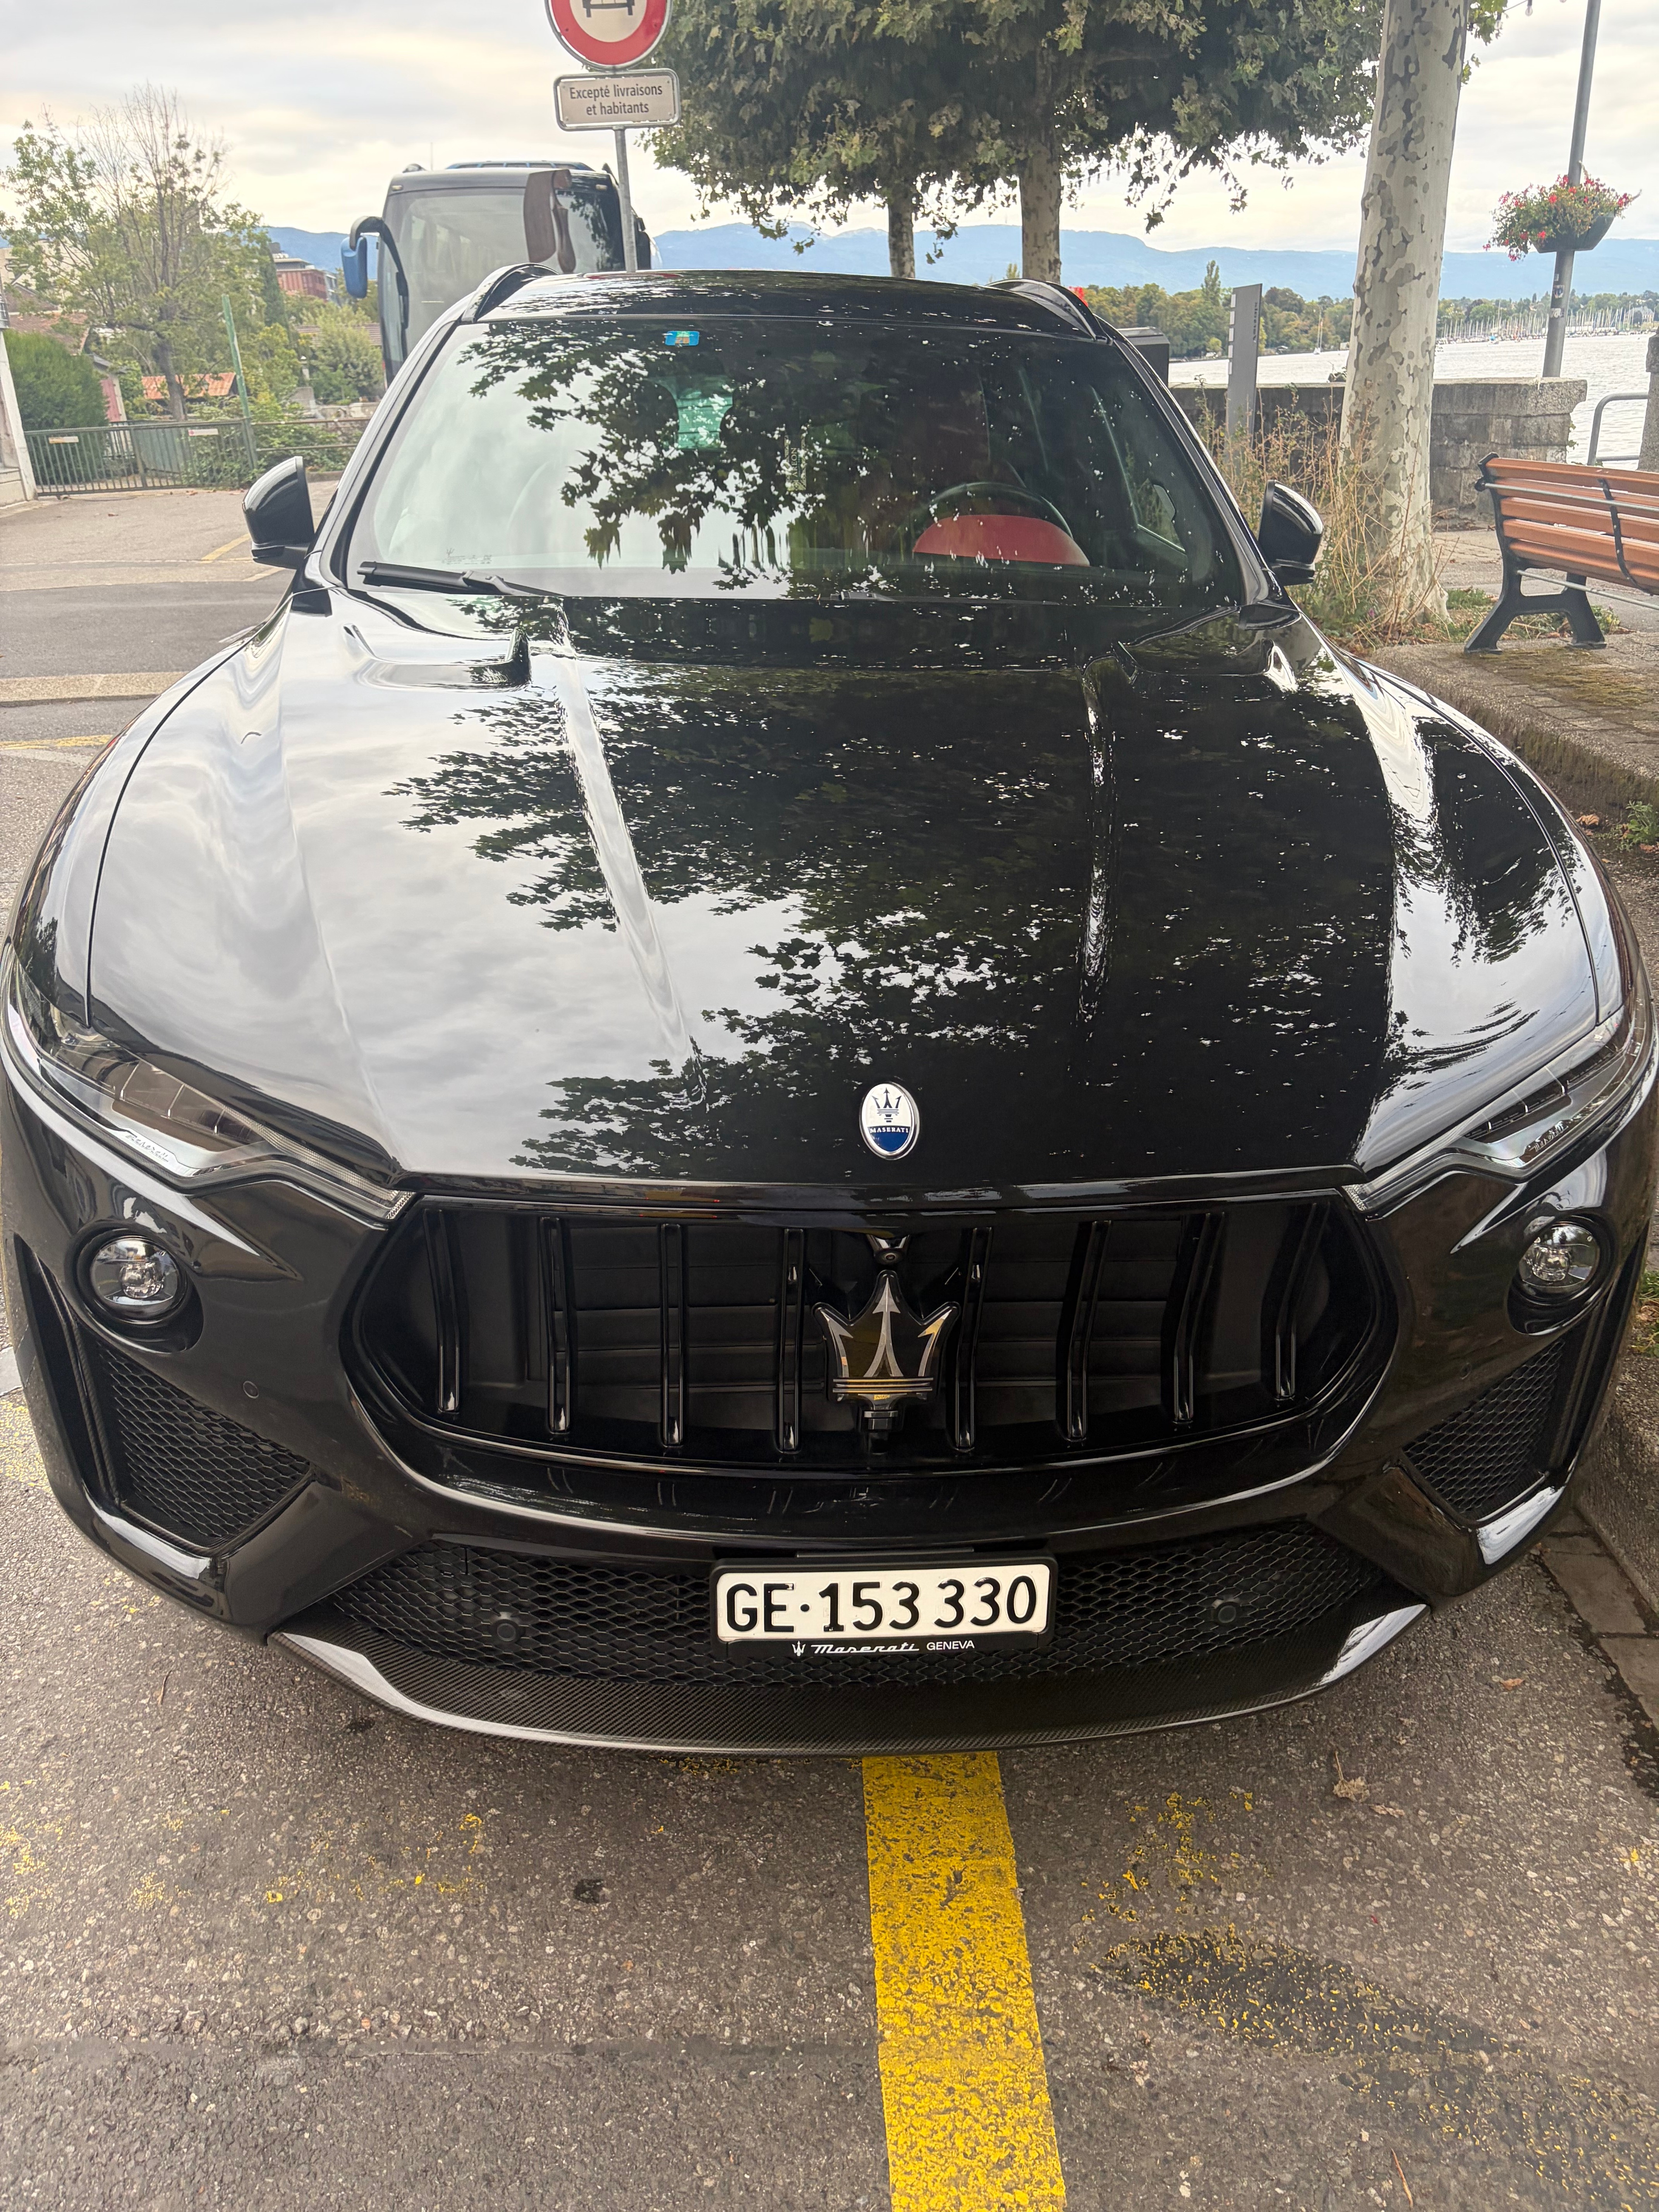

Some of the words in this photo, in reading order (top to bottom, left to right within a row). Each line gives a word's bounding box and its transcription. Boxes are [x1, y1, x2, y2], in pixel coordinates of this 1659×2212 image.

[570, 85, 610, 101] Excepté
[613, 84, 663, 97] livraisons
[586, 105, 597, 115] et
[600, 101, 649, 115] habitants
[811, 1642, 919, 1654] Maserati
[926, 1640, 975, 1651] GENEVA
